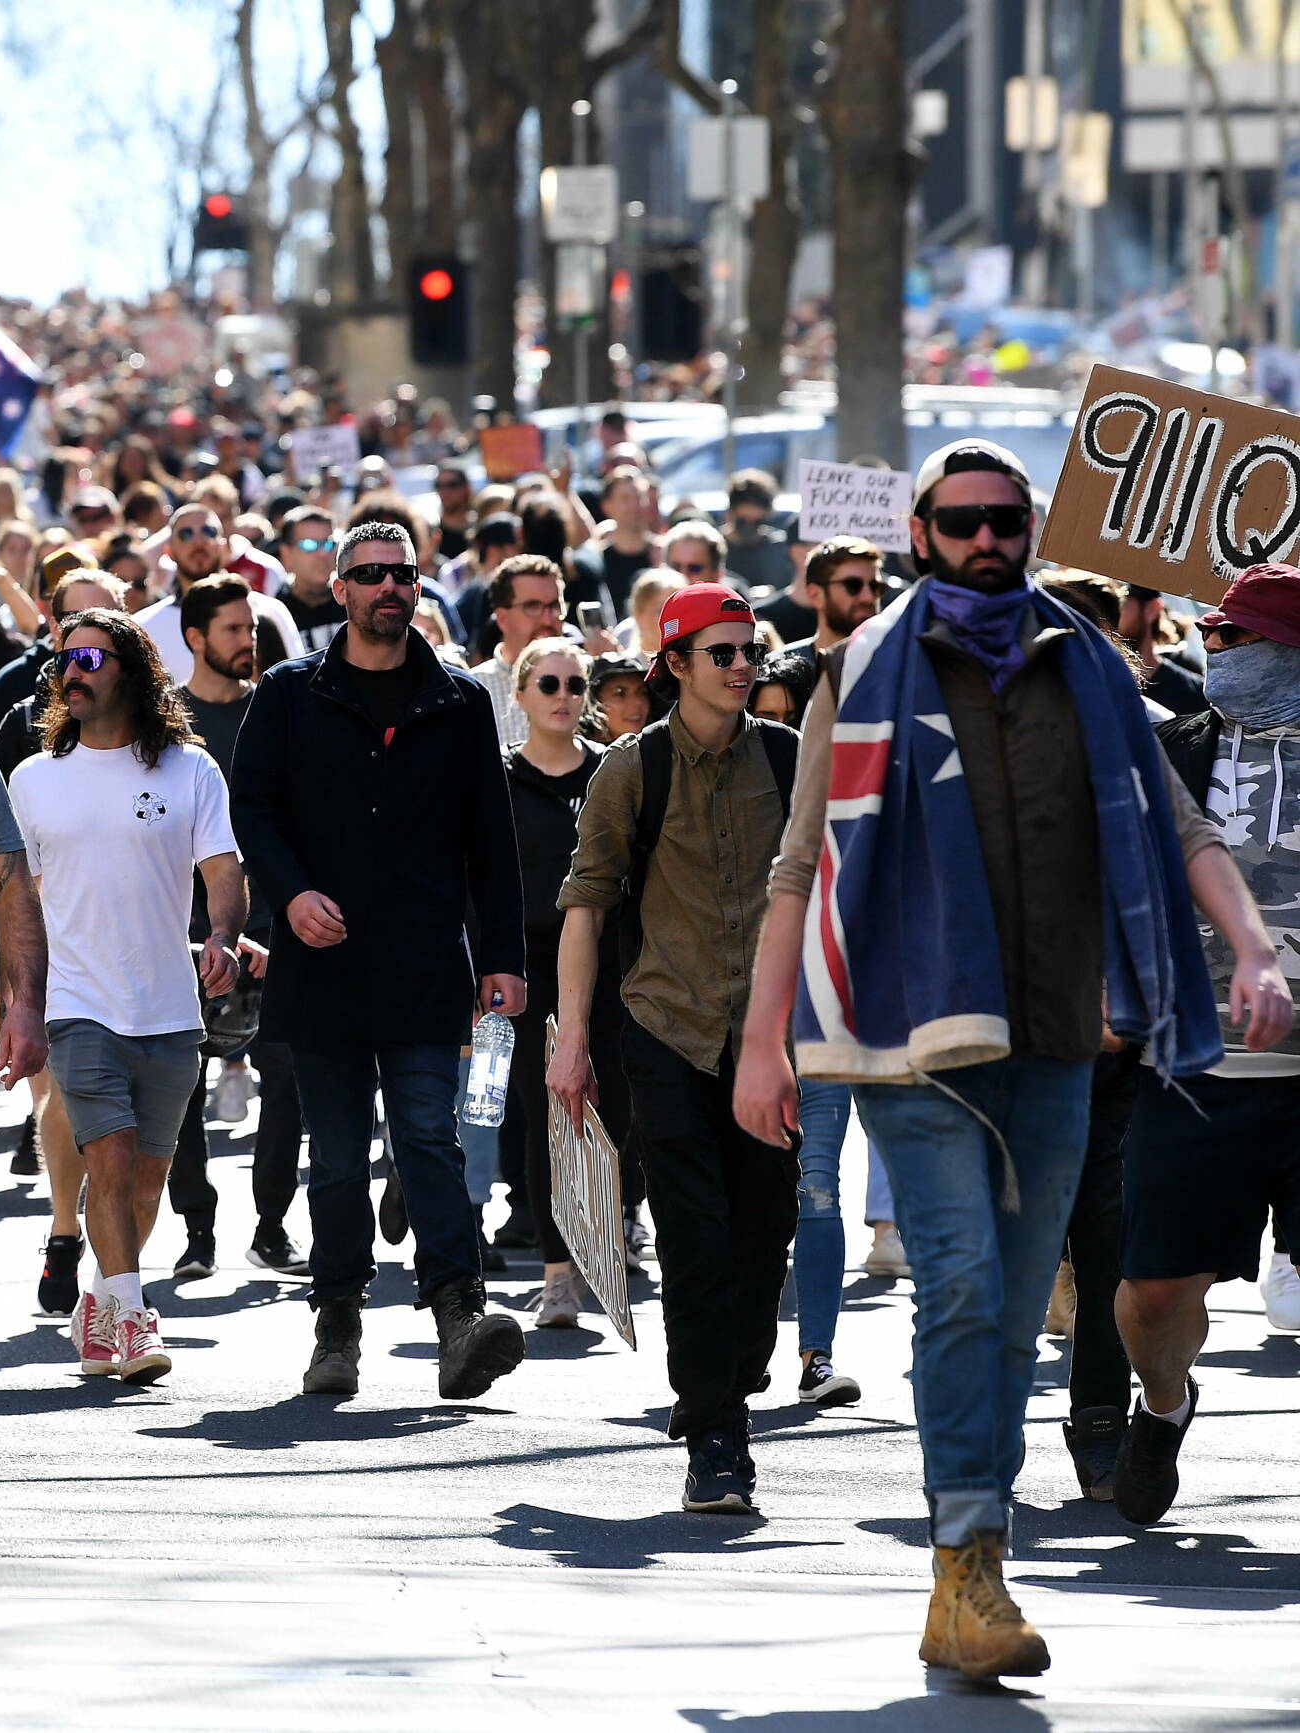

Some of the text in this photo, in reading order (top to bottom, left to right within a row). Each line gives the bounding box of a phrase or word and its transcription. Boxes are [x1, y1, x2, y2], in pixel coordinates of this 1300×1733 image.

[807, 467, 898, 489] LEAVE OUR
[810, 485, 891, 508] FUCKING
[808, 513, 839, 529] KIDS
